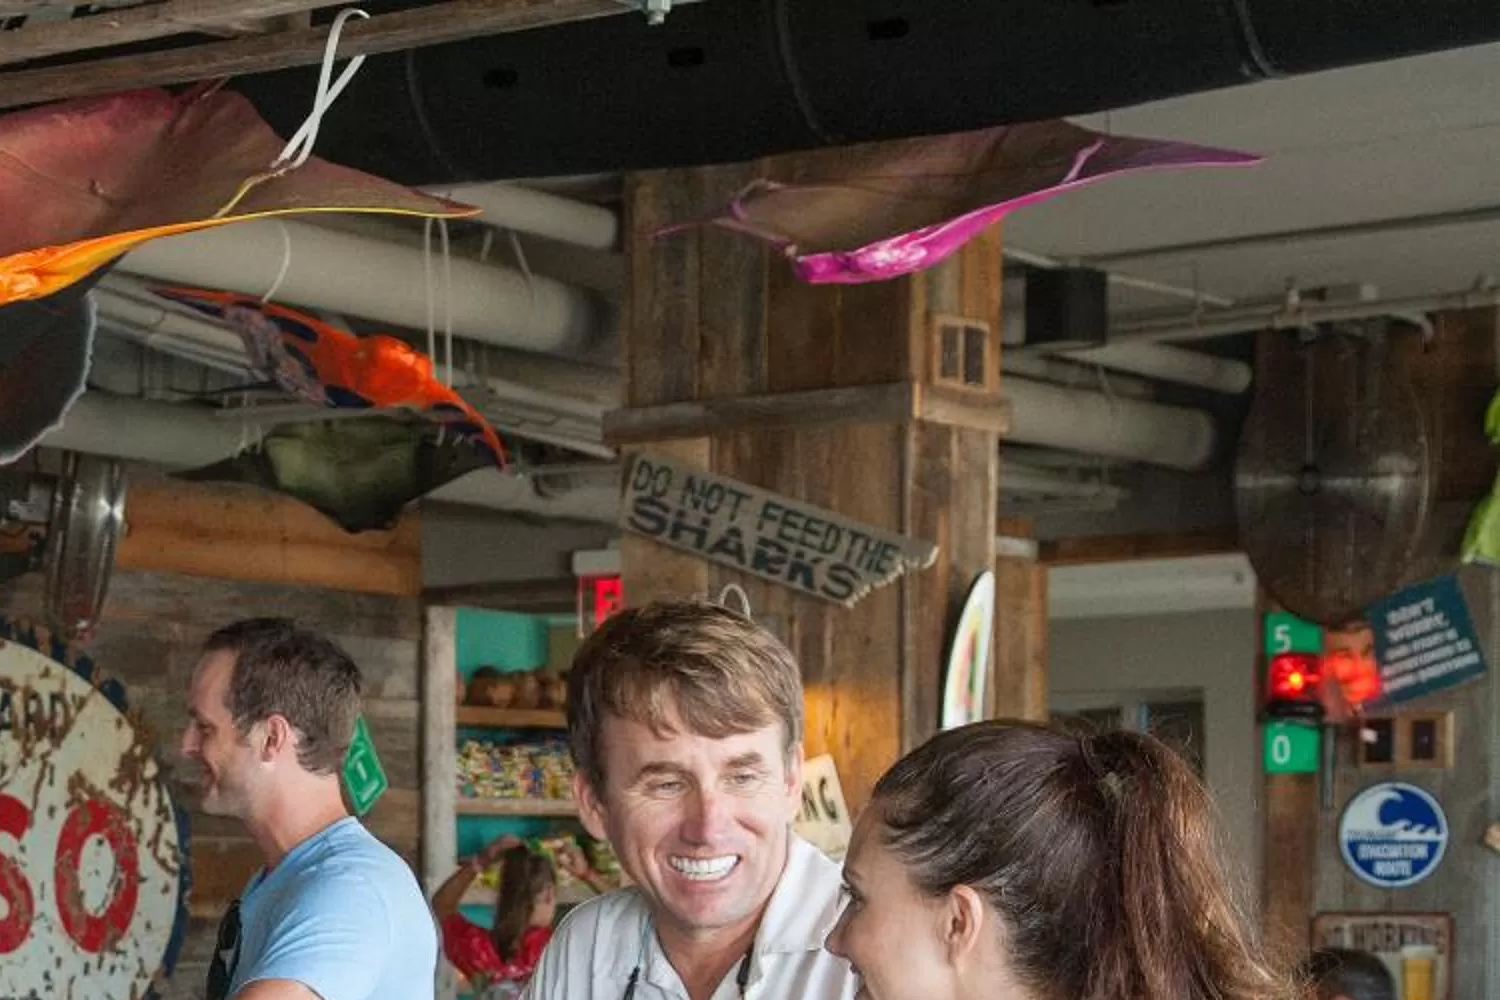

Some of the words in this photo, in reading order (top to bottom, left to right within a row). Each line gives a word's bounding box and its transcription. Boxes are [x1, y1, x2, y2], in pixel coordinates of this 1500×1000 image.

[628, 496, 862, 600] SHARKS
[632, 458, 673, 499] DO
[681, 475, 751, 522] NOT
[757, 502, 844, 556] FEED
[841, 526, 898, 575] THE
